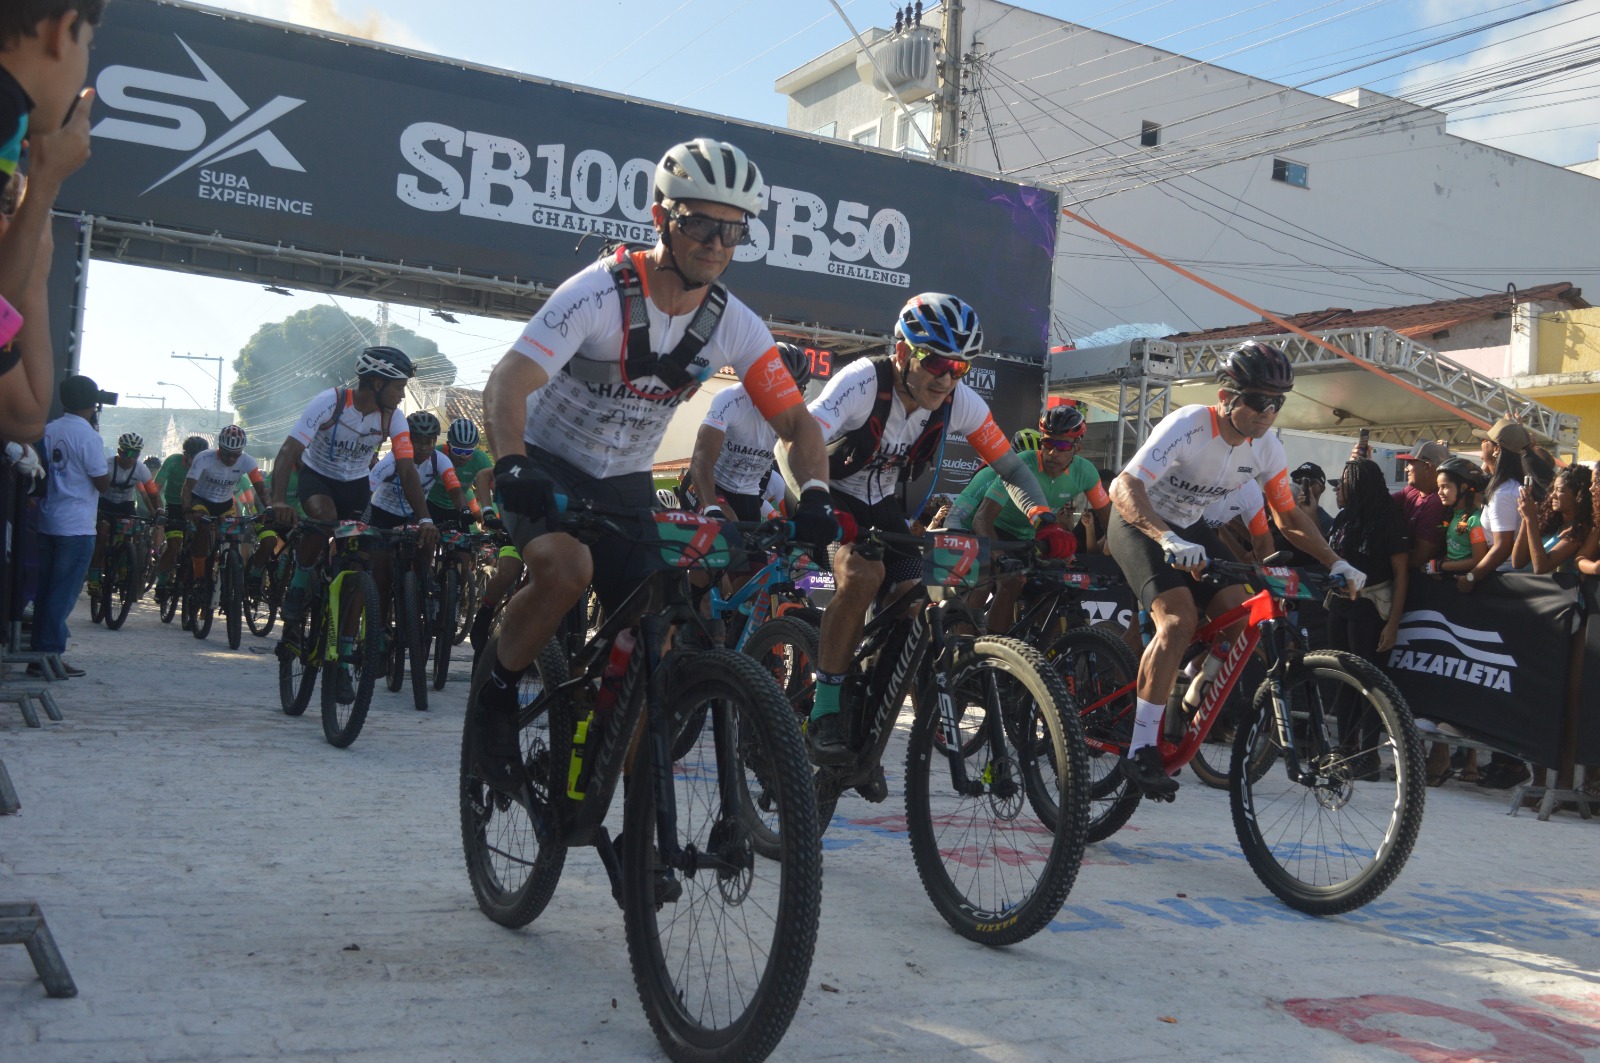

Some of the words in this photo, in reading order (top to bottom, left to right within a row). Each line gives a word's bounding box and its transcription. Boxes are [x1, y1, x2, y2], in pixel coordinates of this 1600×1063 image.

[199, 168, 251, 191] SUBA
[397, 121, 656, 224] SB100
[199, 185, 314, 216] EXPERIENCE
[531, 208, 655, 243] CHALLENGE
[827, 261, 906, 286] CHALLENGE
[1072, 574, 1082, 582] 25
[1188, 630, 1249, 742] SPECIALIZED
[1387, 649, 1513, 694] FAZATLETA
[974, 914, 1019, 932] MAXXIS
